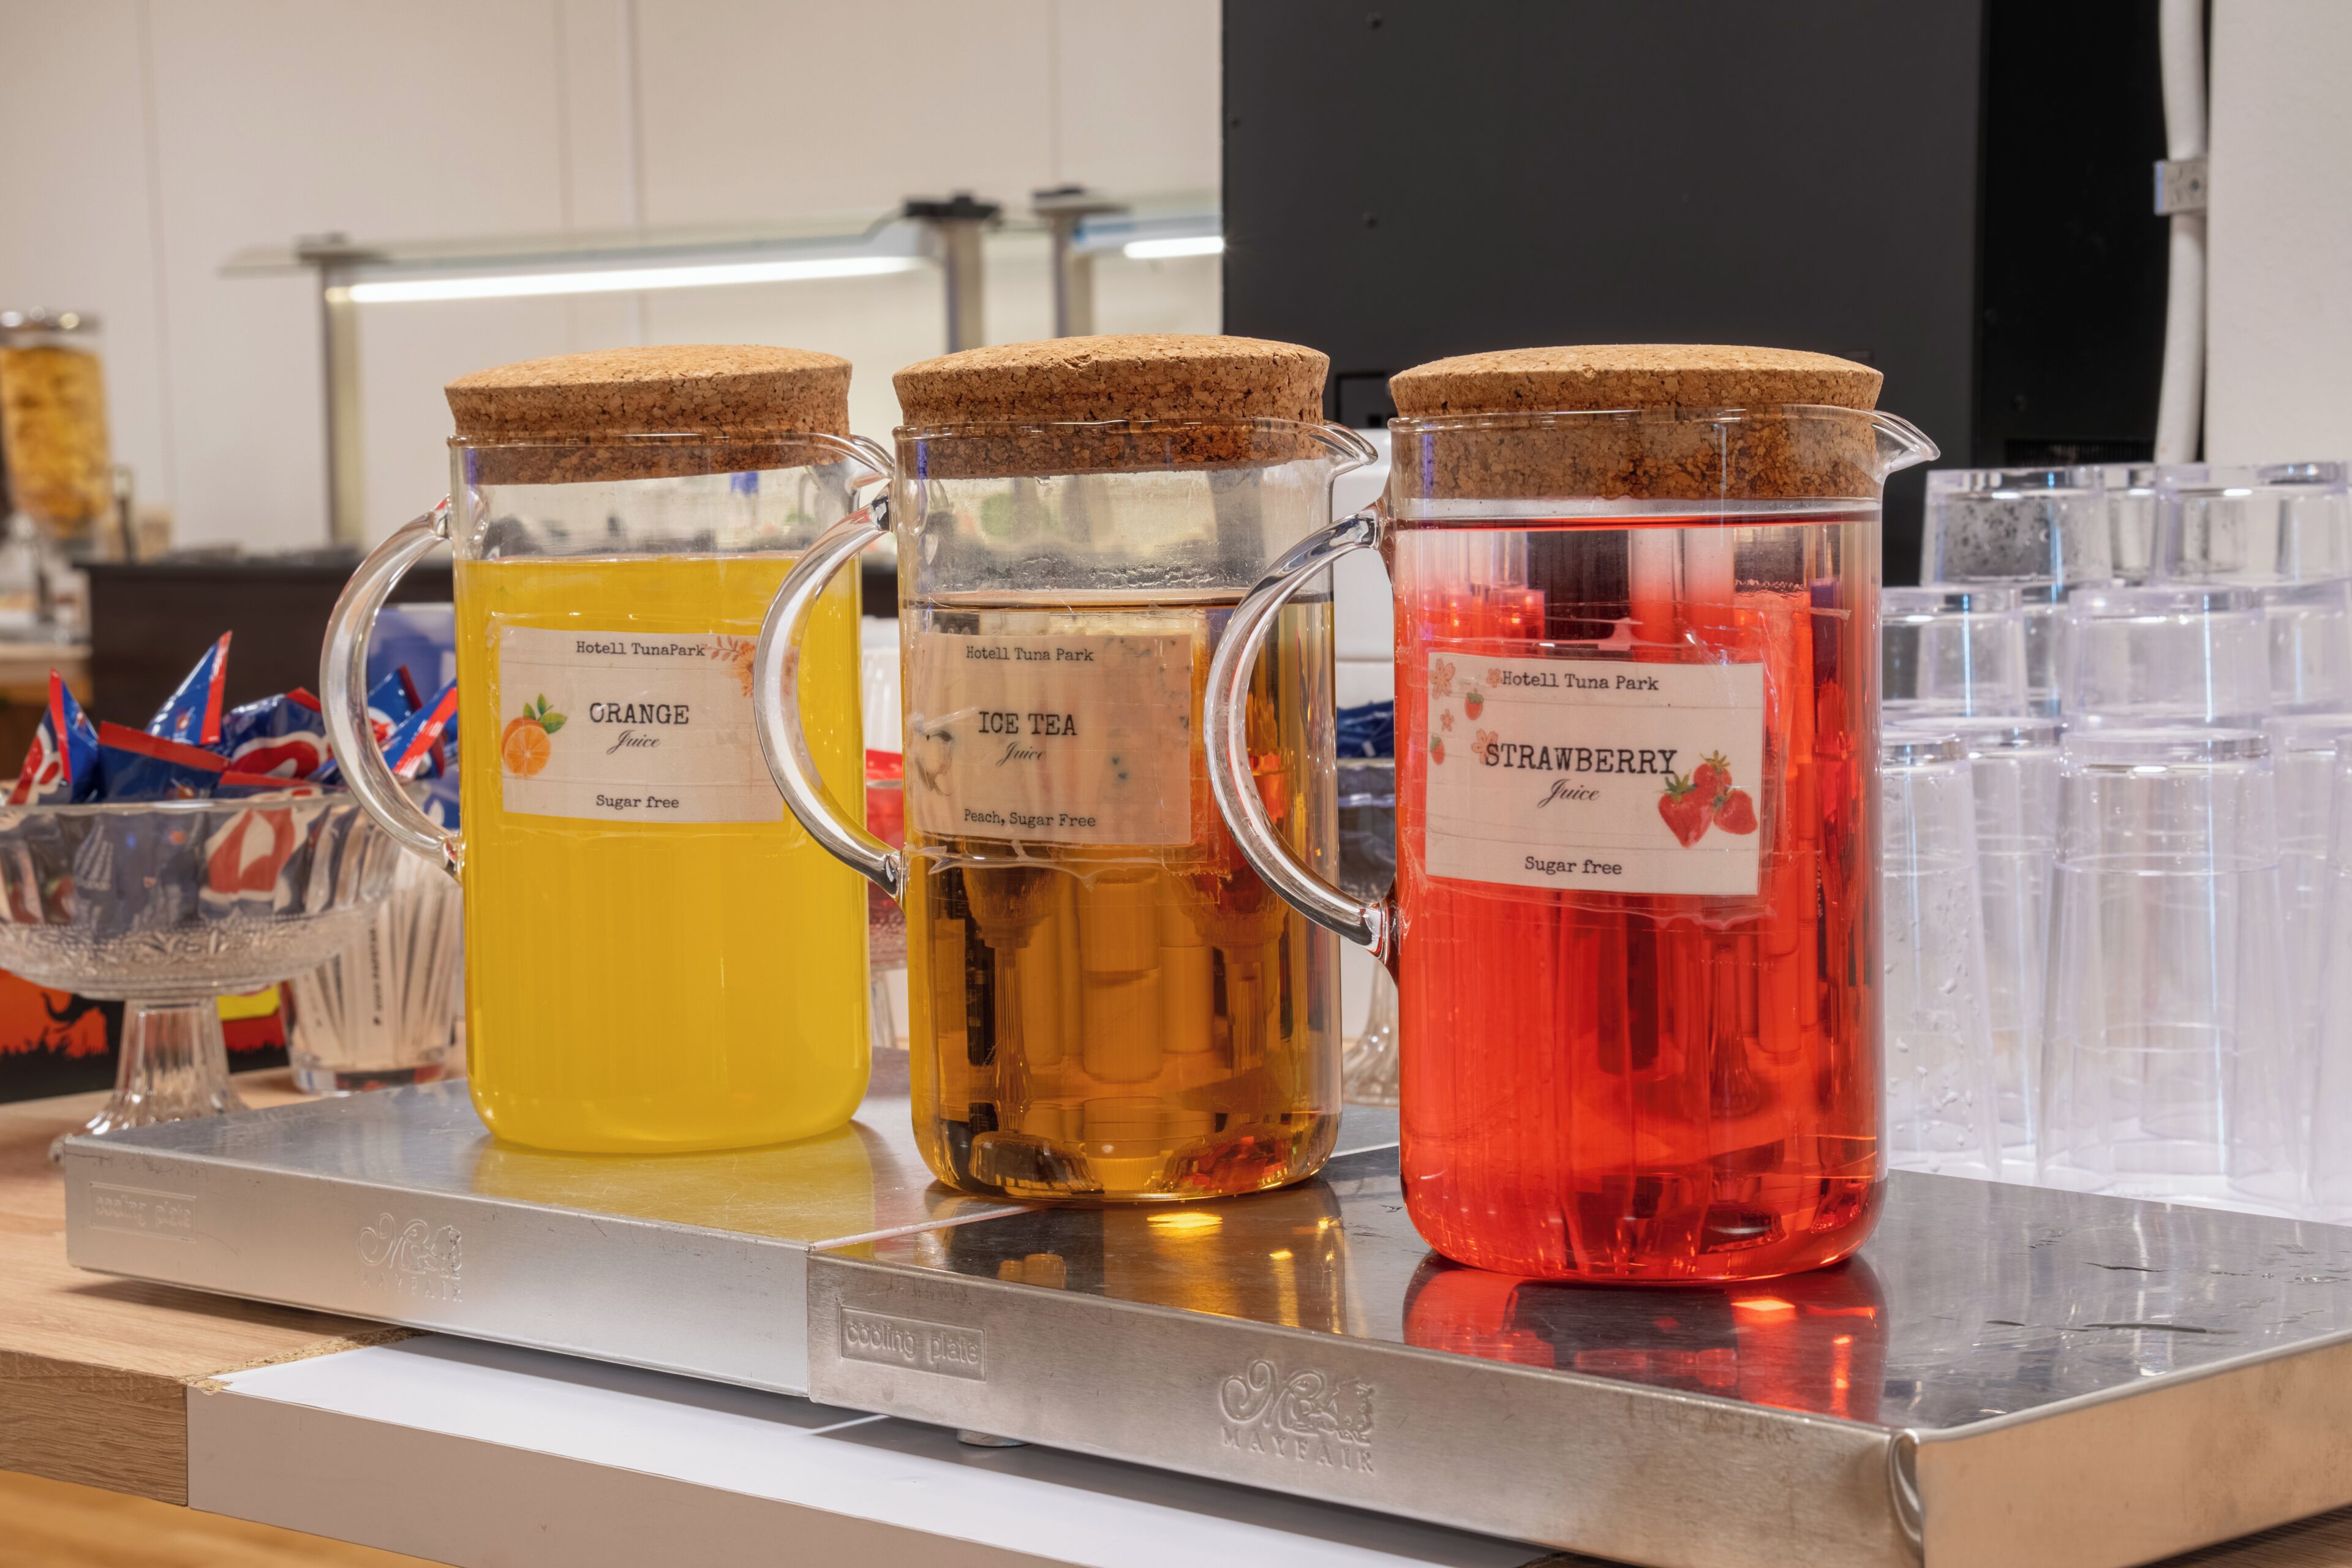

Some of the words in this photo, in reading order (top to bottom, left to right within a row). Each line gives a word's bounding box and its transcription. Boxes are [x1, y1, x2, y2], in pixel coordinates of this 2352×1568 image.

[577, 641, 626, 655] Hotell
[967, 646, 1010, 660] Hotell
[1014, 647, 1050, 661] Tuna
[1055, 648, 1095, 662] Park
[1502, 671, 1559, 687] Hotell
[1565, 673, 1609, 689] Tuna
[1615, 676, 1659, 691] Park
[590, 703, 689, 725] ORANGE
[979, 711, 1019, 734] ICE
[1028, 714, 1077, 736] TEA
[606, 730, 660, 755] Juice
[997, 741, 1047, 766] Juice
[1485, 742, 1677, 774] STRAWBERRY
[596, 795, 641, 810] Sugar
[646, 796, 679, 809] free
[1537, 778, 1600, 809] Juice
[964, 809, 1005, 827] Peach,
[1009, 812, 1054, 829] Sugar
[1058, 813, 1096, 827] Free
[1525, 856, 1577, 875] Sugar
[1581, 859, 1622, 875] free
[846, 1322, 916, 1360] cooling
[929, 1332, 979, 1363] plate
[1221, 1425, 1374, 1474] MAYFAIR
